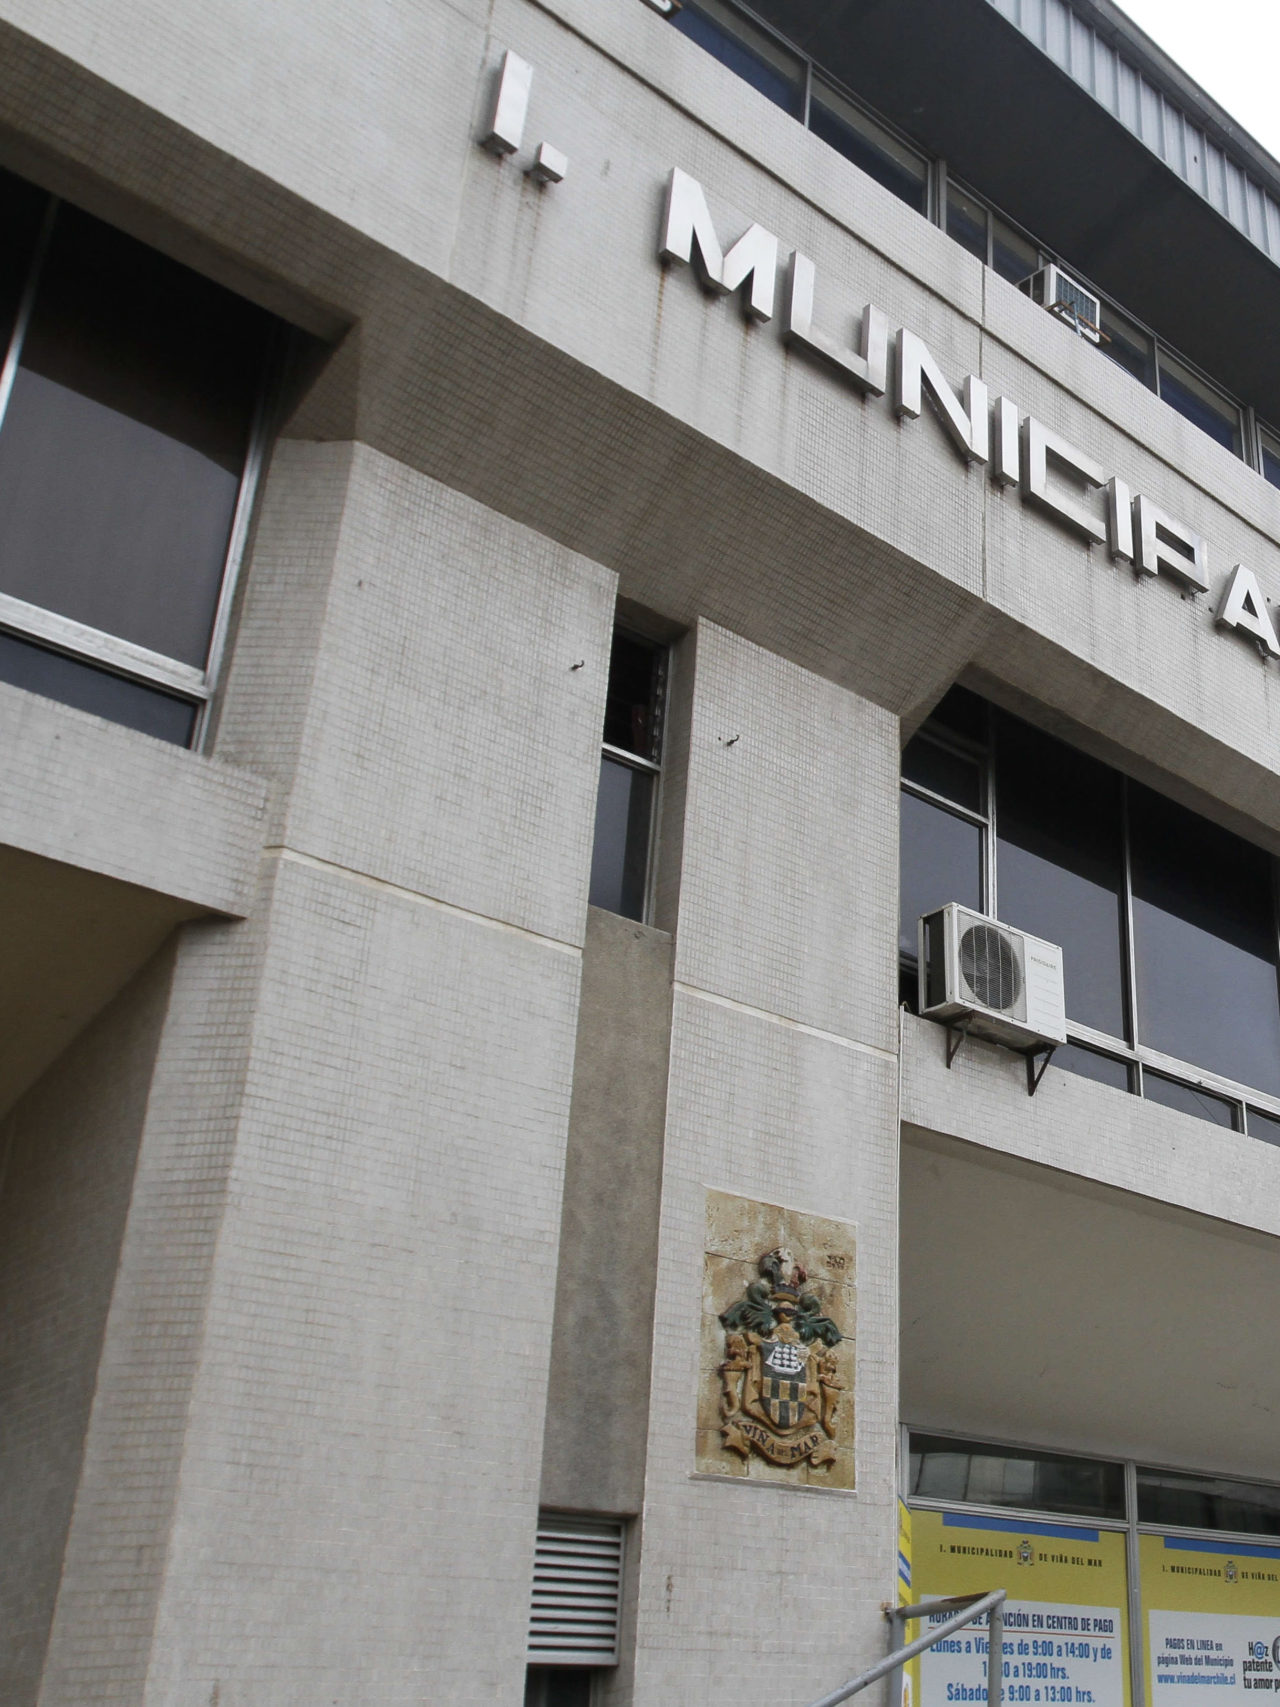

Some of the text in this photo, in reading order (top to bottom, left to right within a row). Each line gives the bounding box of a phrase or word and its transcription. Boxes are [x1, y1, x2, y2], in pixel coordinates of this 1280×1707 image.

[486, 50, 568, 183] I.
[950, 1545, 1013, 1559] MUNICIPALIDAD
[1039, 1553, 1048, 1561] DE
[1051, 1553, 1068, 1564] VIÑA
[1071, 1556, 1085, 1566] DEL
[1087, 1558, 1103, 1567] MAR
[1170, 1565, 1222, 1577] MUNICIPALIDAD
[1267, 1573, 1279, 1581] DEL
[985, 1608, 1029, 1628] ANCIÓN
[1032, 1613, 1044, 1628] EN
[1046, 1615, 1079, 1631] CENTRO
[1081, 1617, 1091, 1632] DE
[1093, 1618, 1114, 1633] PAGO
[965, 1640, 972, 1654] a
[974, 1637, 1014, 1655] Viees
[1018, 1639, 1029, 1655] de
[1032, 1639, 1054, 1657] 9:00
[1056, 1644, 1063, 1657] a
[1065, 1642, 1090, 1659] 14:00
[1093, 1645, 1098, 1662] y
[1100, 1643, 1112, 1660] de
[1165, 1637, 1185, 1650] PAGOS
[1186, 1638, 1195, 1650] EN
[1215, 1642, 1223, 1652] en
[1179, 1654, 1193, 1666] Web
[1194, 1655, 1204, 1666] del
[1204, 1655, 1234, 1669] Municipio
[1242, 1659, 1273, 1673] patente
[1013, 1665, 1019, 1678] a
[1022, 1662, 1048, 1679] 19:00
[1050, 1663, 1070, 1680] hrs.
[1243, 1675, 1252, 1689] tu
[1253, 1677, 1273, 1690] amor
[947, 1682, 989, 1701] Sábado
[1008, 1684, 1031, 1702] 9:00
[1034, 1689, 1041, 1702] a
[1044, 1685, 1073, 1703] 13:00
[1075, 1685, 1096, 1704] hrs.
